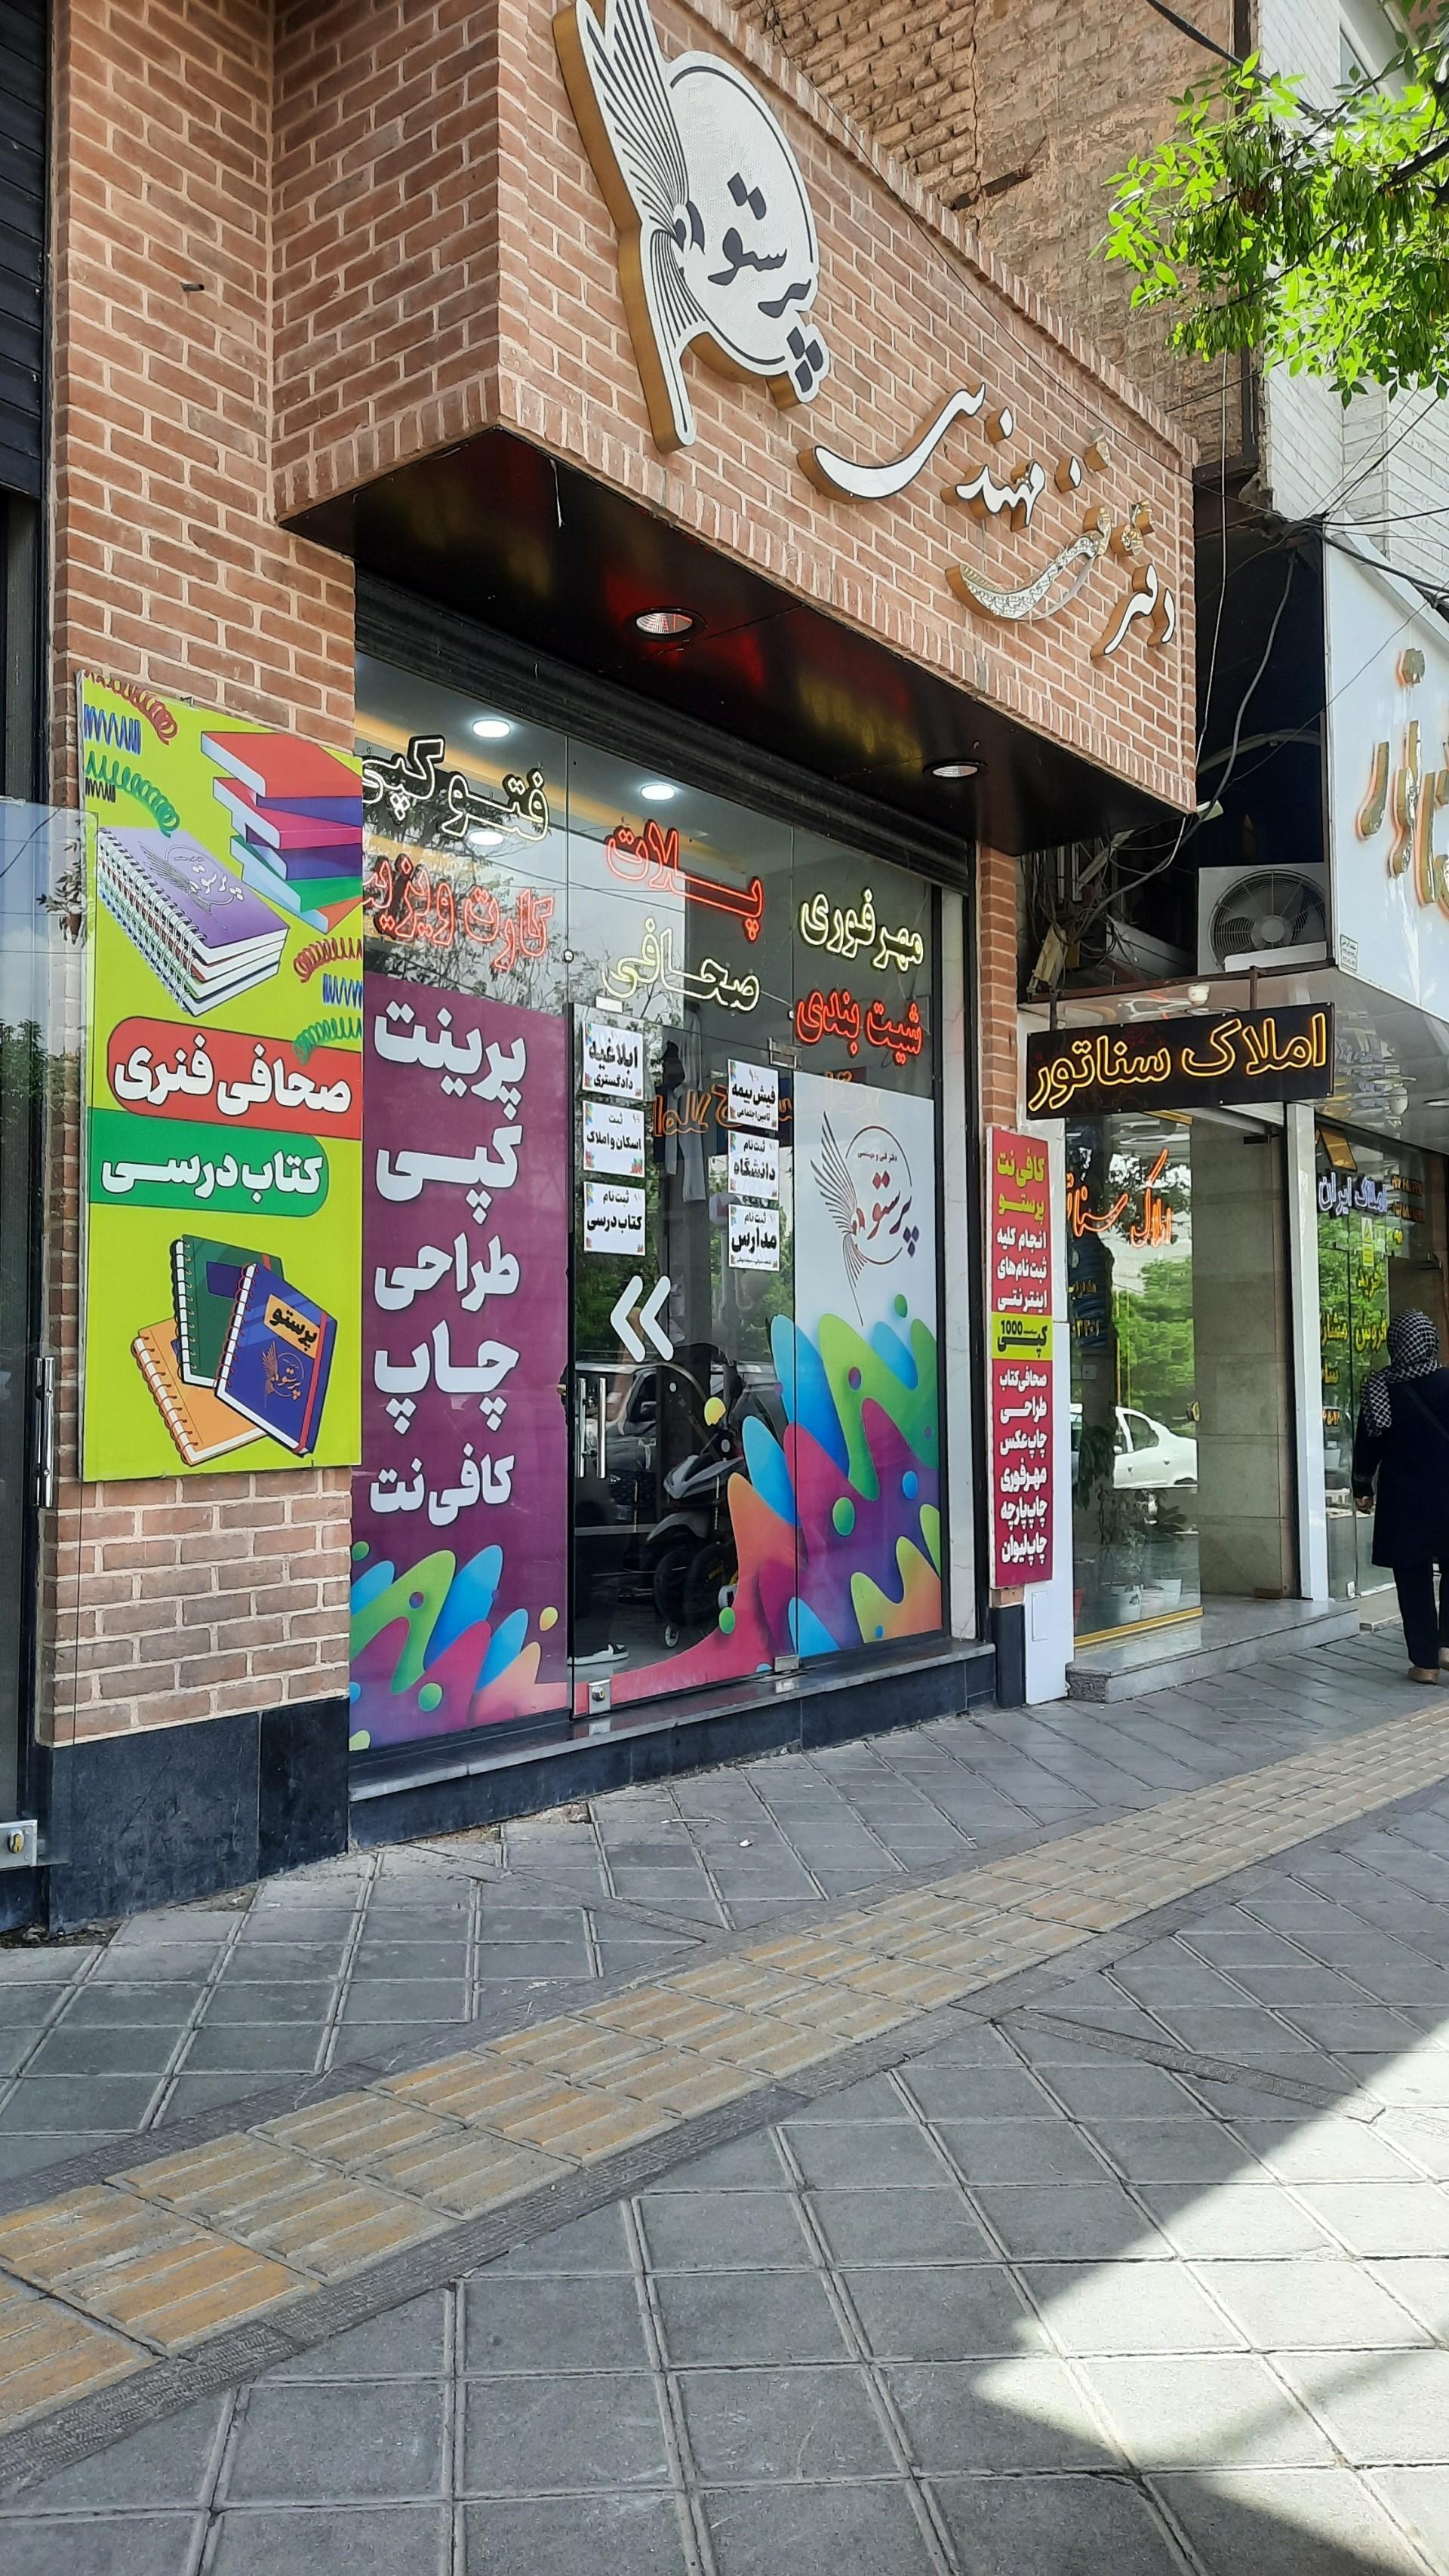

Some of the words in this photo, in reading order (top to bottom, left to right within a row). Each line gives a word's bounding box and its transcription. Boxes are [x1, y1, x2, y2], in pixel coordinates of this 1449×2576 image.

[606, 821, 763, 941] پلات
[361, 859, 456, 947] ویزی
[463, 888, 555, 971] کارت
[800, 888, 876, 959] فوری
[601, 917, 761, 1012] صحافی
[872, 926, 924, 972] مهر
[796, 991, 860, 1057] بندی
[867, 1002, 922, 1065] شیت
[373, 999, 527, 1121] پرینت
[1181, 1011, 1327, 1078] املاک
[114, 1033, 214, 1106] فنری
[216, 1042, 352, 1116] صحافی
[1028, 1035, 1172, 1113] سناتور
[731, 1082, 752, 1104] بیمه
[608, 1111, 623, 1128] ثبت
[101, 1153, 238, 1199] درسی
[242, 1150, 324, 1203] کتاب
[376, 1124, 524, 1225] کپی
[734, 1157, 776, 1181] دانشگاه
[996, 1150, 1015, 1176] نت
[1016, 1147, 1045, 1188] کافی
[603, 1190, 614, 1205] نام
[615, 1189, 629, 1208] ثبت
[998, 1193, 1045, 1226] پرستو
[586, 1215, 617, 1233] درسی
[618, 1214, 642, 1234] کتاب
[731, 1226, 777, 1254] مدارس
[996, 1226, 1017, 1250] کلیه
[1018, 1228, 1047, 1254] انجام
[374, 1232, 521, 1312] طراحی
[1029, 1255, 1048, 1285] ثبت
[269, 1307, 318, 1352] پرستو
[997, 1325, 1048, 1359] کپی
[1001, 1319, 1023, 1336] 1000
[373, 1319, 519, 1433] چاپ
[998, 1368, 1020, 1392] کتاب
[1017, 1365, 1048, 1393] صحافی
[1000, 1395, 1048, 1424] طراحی
[999, 1429, 1027, 1456] عکس
[1027, 1428, 1048, 1459] چاپ
[369, 1457, 426, 1514] نت
[428, 1442, 515, 1528] کافی
[1000, 1457, 1026, 1493] فوری
[1023, 1467, 1048, 1492] مهر
[1000, 1496, 1028, 1531] پارچه
[1027, 1494, 1048, 1528] چاپ
[1001, 1533, 1027, 1564] لیوان
[1027, 1531, 1048, 1566] چاپ
